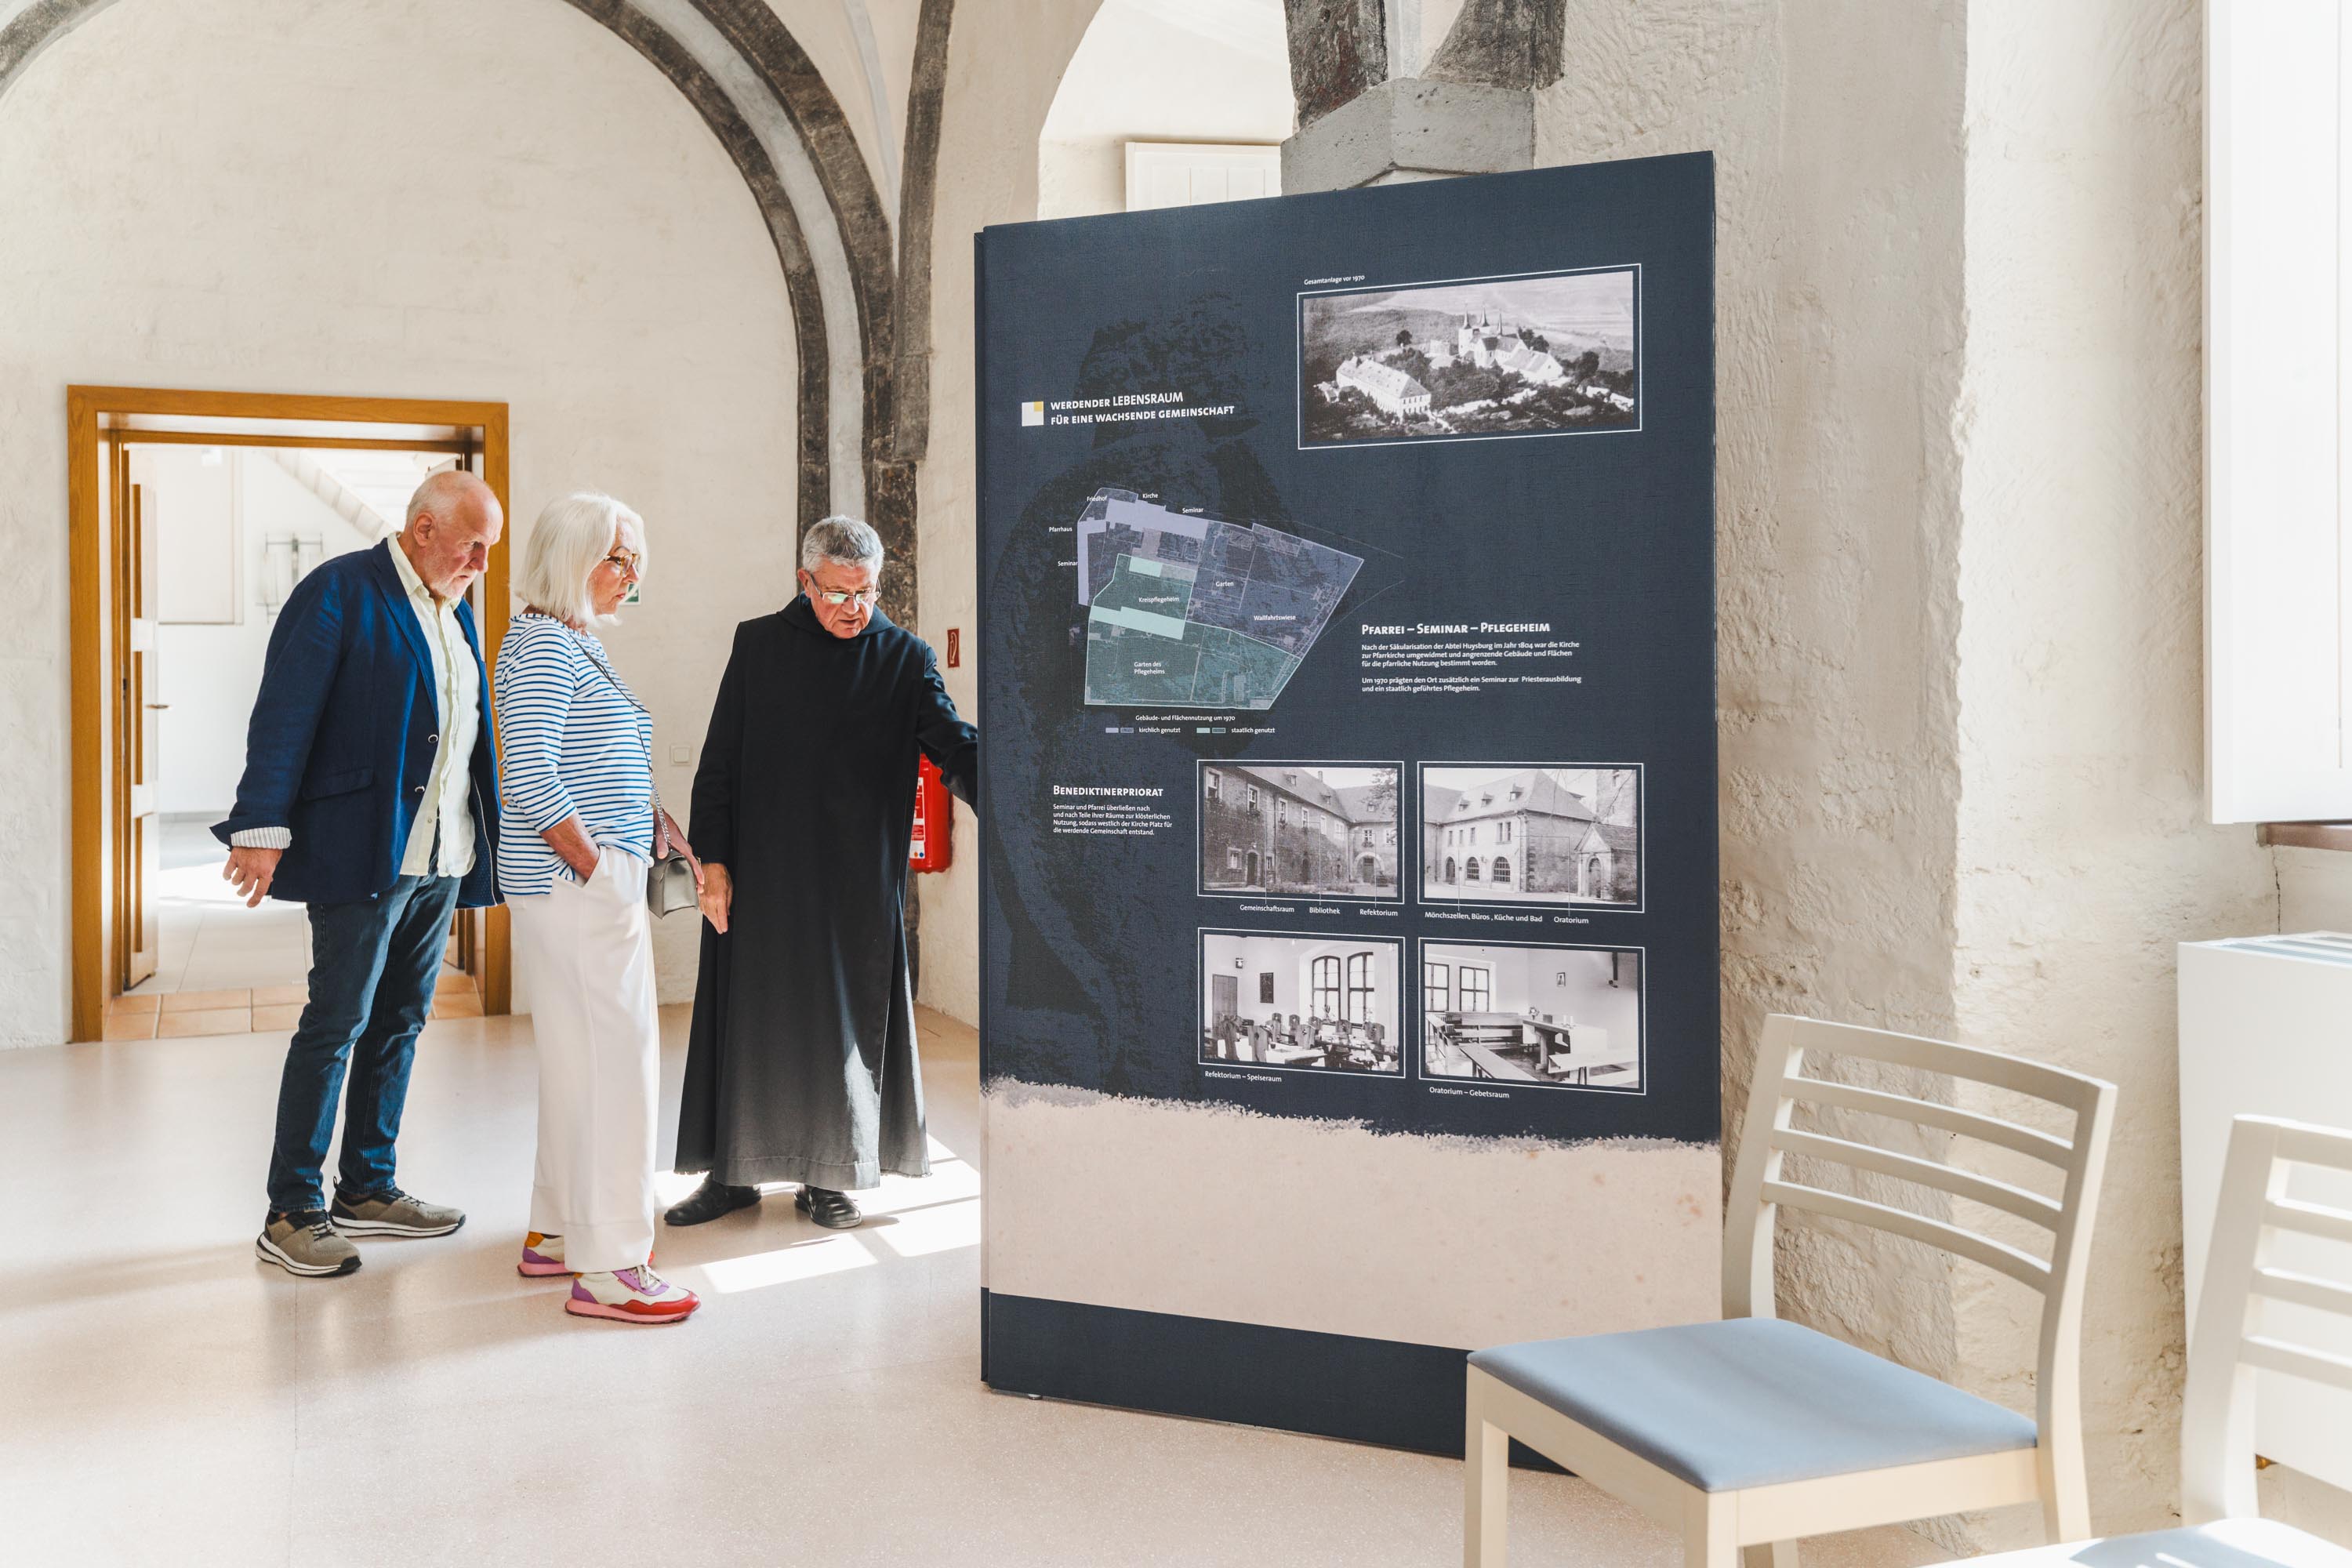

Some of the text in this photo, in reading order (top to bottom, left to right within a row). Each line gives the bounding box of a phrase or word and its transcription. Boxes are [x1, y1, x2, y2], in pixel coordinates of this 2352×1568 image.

[1304, 277, 1342, 285] Gesamtanlage
[1051, 392, 1183, 410] WERDENDER LEBENSRAUM
[1051, 405, 1235, 425] FÜR EINE WACHSENDE GEMEINSCHAFT
[1240, 905, 1294, 913] Gemeinschaftsraum
[1425, 911, 1471, 920] Mönchszellen,
[1553, 916, 1589, 924] Oratorium
[1204, 1071, 1241, 1080] Refektorium
[1247, 1073, 1282, 1083] Speiseraum
[1429, 1087, 1463, 1095] Oratorium
[1469, 1090, 1510, 1098] Gebetsraum
